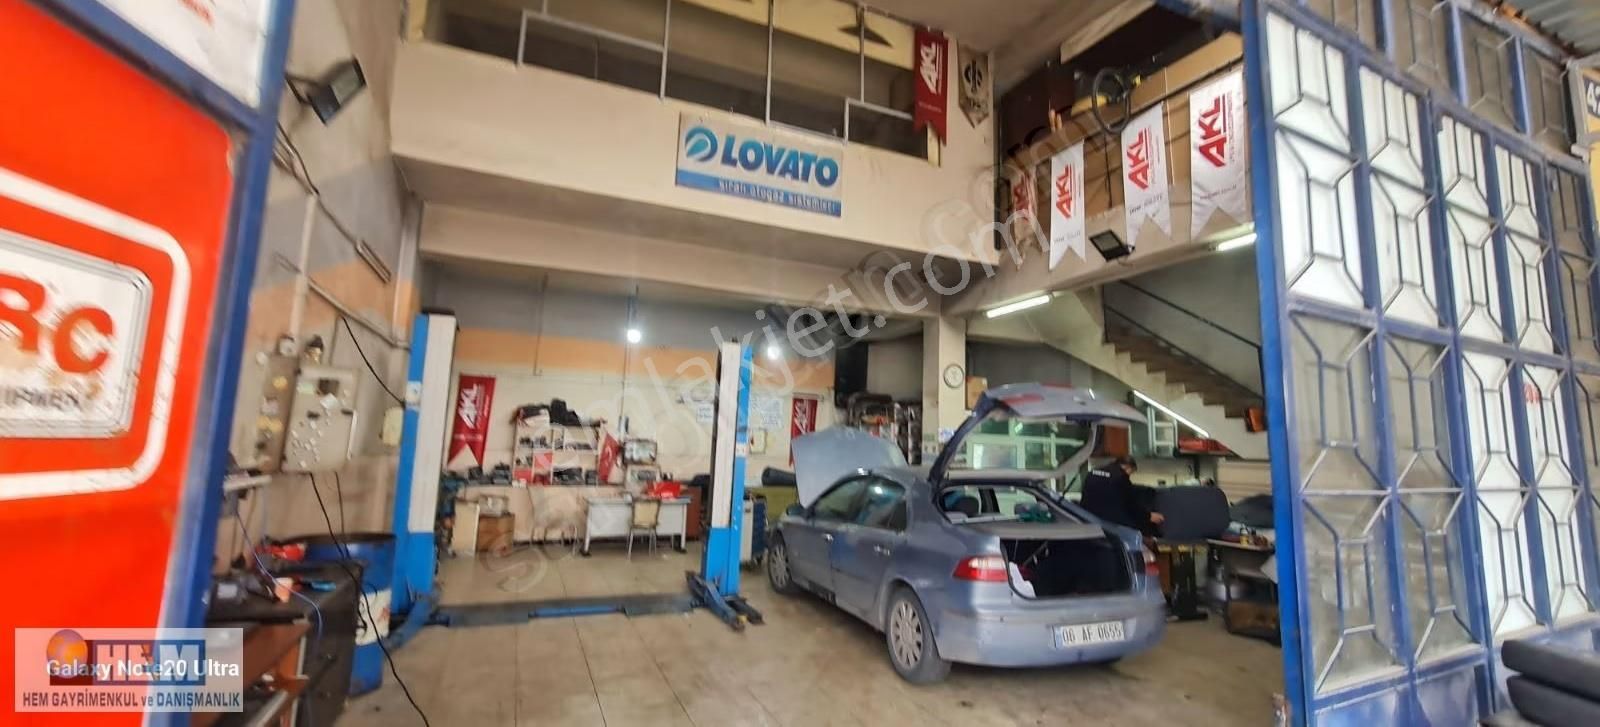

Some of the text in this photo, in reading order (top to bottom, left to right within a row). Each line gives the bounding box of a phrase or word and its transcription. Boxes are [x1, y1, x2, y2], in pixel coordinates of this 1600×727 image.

[920, 42, 938, 94] AKL
[1199, 94, 1227, 167] AKL
[721, 134, 839, 187] LOVATO
[1127, 129, 1149, 191] AKL
[1056, 163, 1072, 219] AKL
[458, 383, 478, 429] AKL
